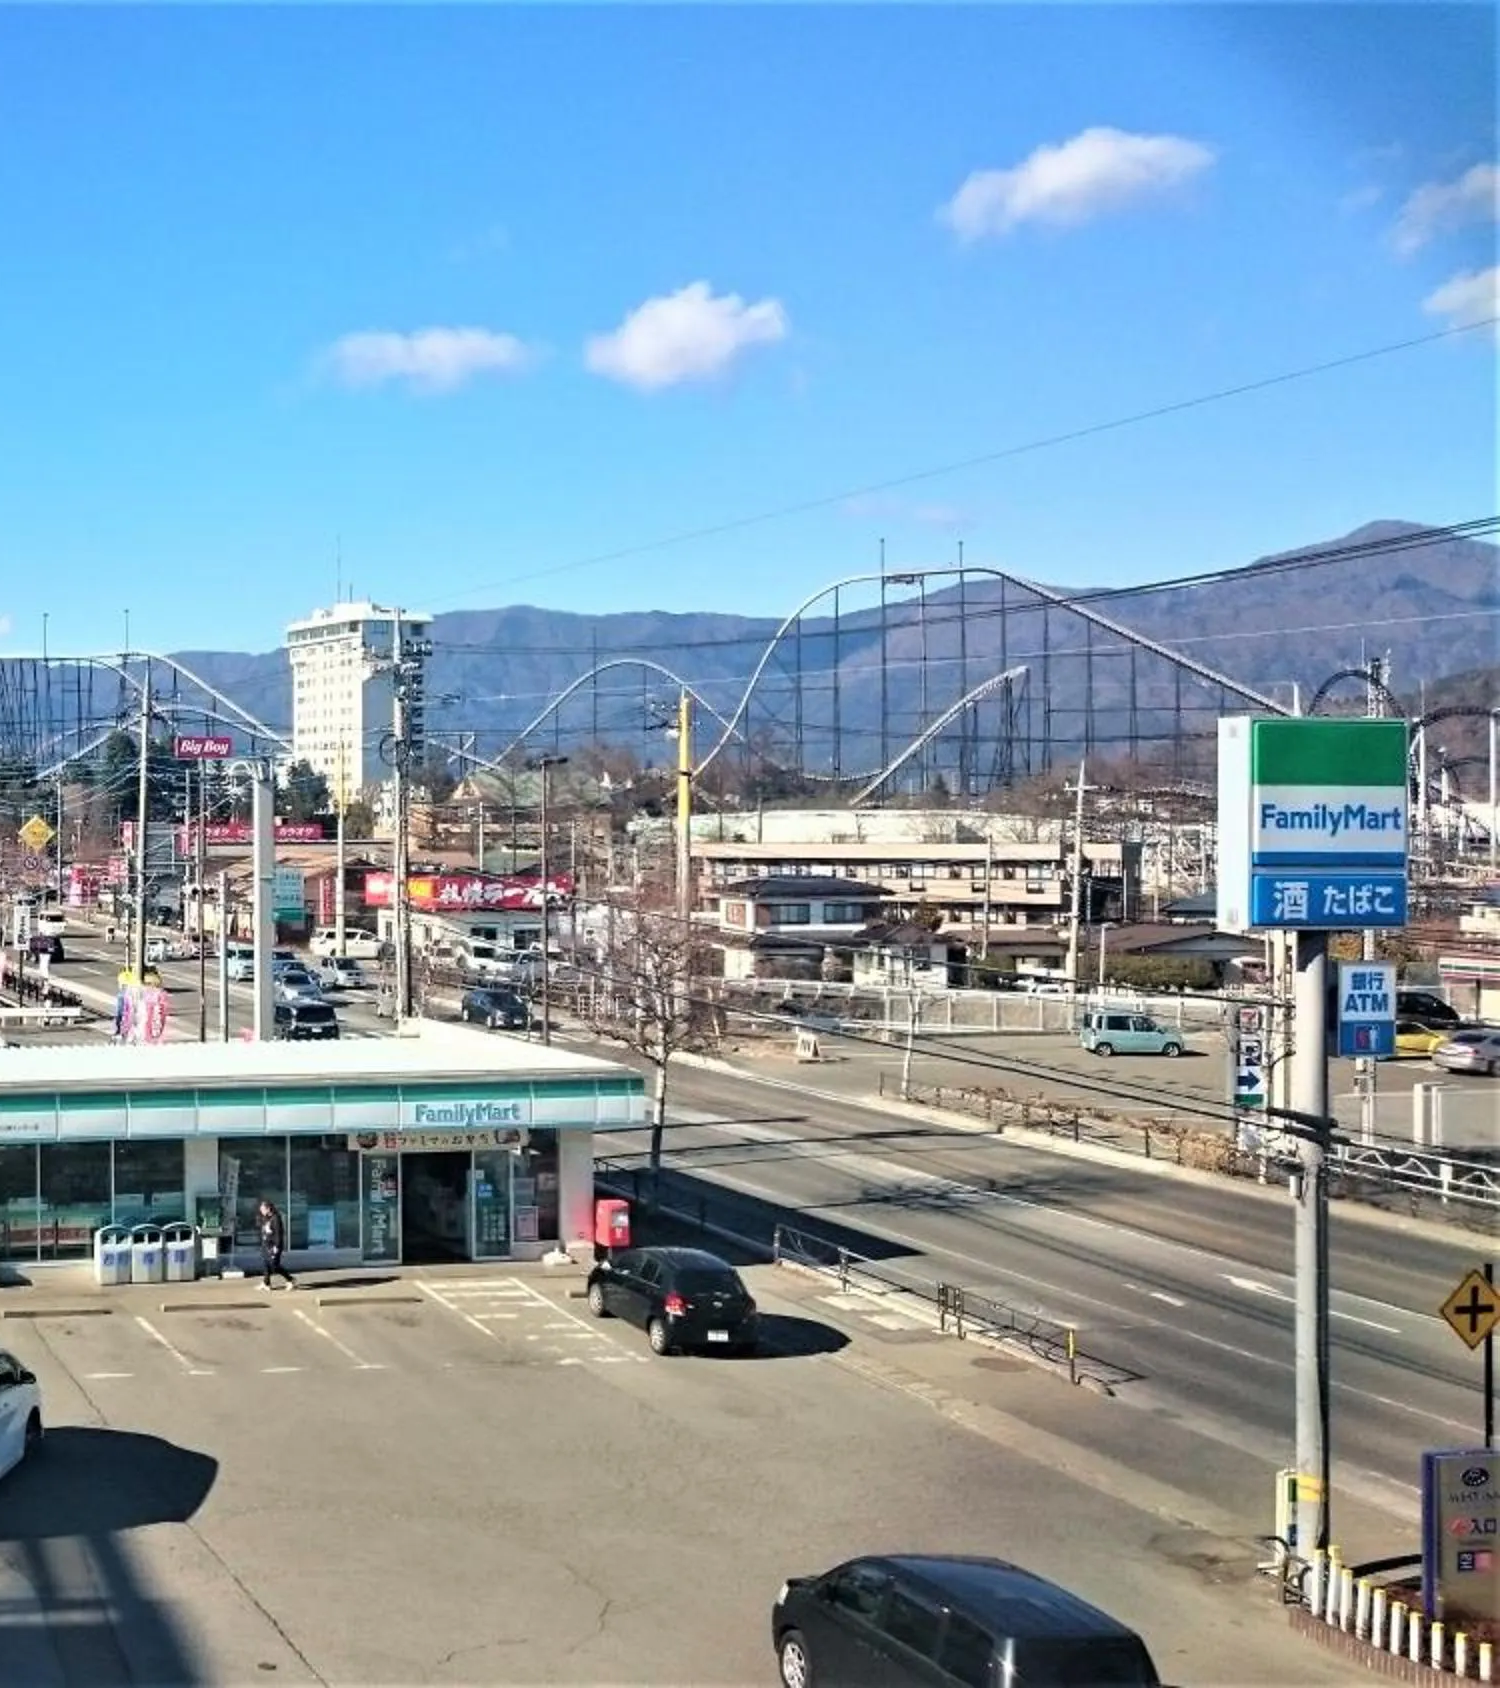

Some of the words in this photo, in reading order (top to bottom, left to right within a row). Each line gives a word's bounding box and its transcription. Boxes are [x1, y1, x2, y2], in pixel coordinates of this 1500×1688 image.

[180, 739, 202, 753] Big
[203, 738, 229, 753] Boy
[1260, 803, 1402, 836] FamilyMart
[1273, 881, 1310, 920] 酒
[1323, 884, 1396, 916] たばこ
[1351, 970, 1385, 991] 銀行
[1344, 993, 1390, 1013] ATM
[415, 1103, 521, 1126] FamilyMart
